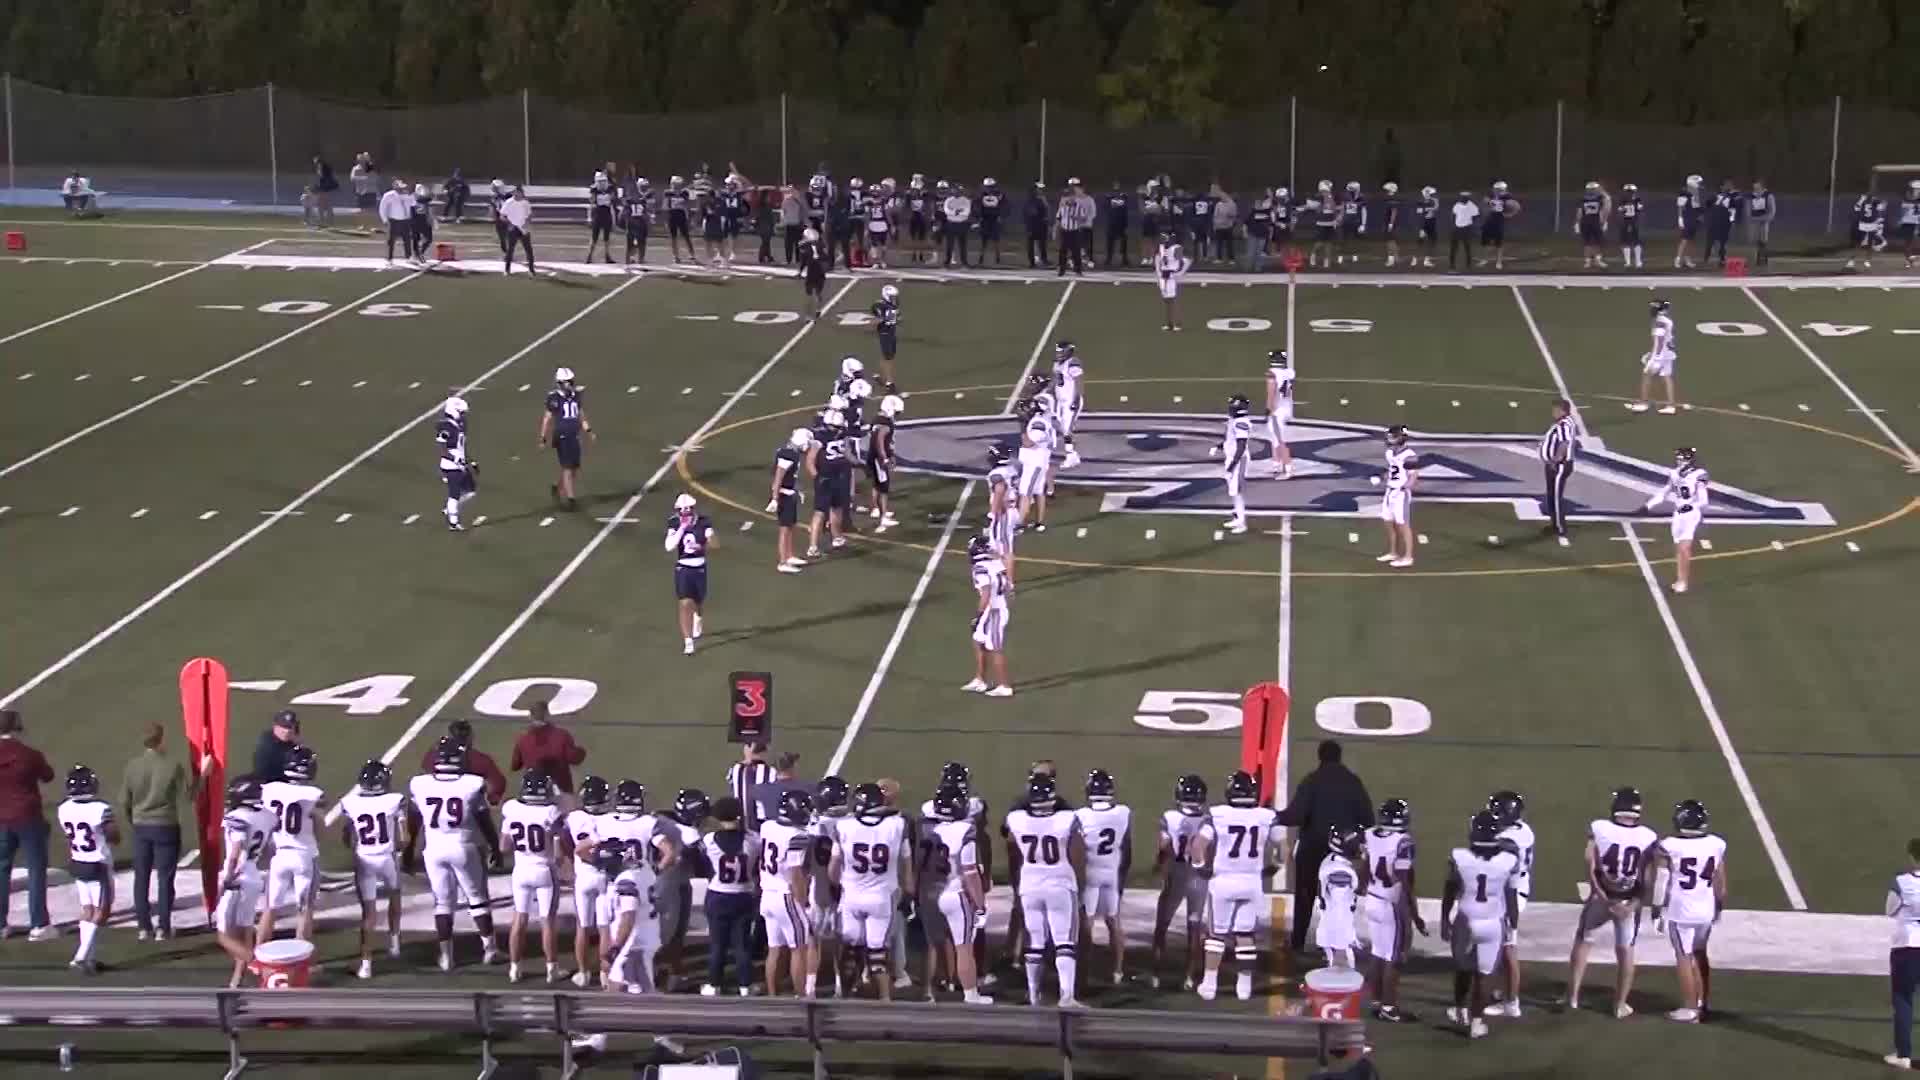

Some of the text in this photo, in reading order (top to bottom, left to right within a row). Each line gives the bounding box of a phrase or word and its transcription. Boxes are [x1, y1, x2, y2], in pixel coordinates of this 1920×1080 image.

[735, 680, 767, 717] 3
[426, 797, 463, 828] 79
[357, 812, 390, 846] 21
[510, 821, 546, 853] 20
[1097, 827, 1116, 856] 2
[1228, 825, 1259, 859] 71
[852, 843, 890, 874] 59
[1021, 834, 1060, 865] 70
[1602, 842, 1642, 877] 40
[1678, 855, 1716, 889] 54
[1475, 873, 1488, 903] 1
[267, 973, 289, 989] G
[1321, 1003, 1343, 1020] G
